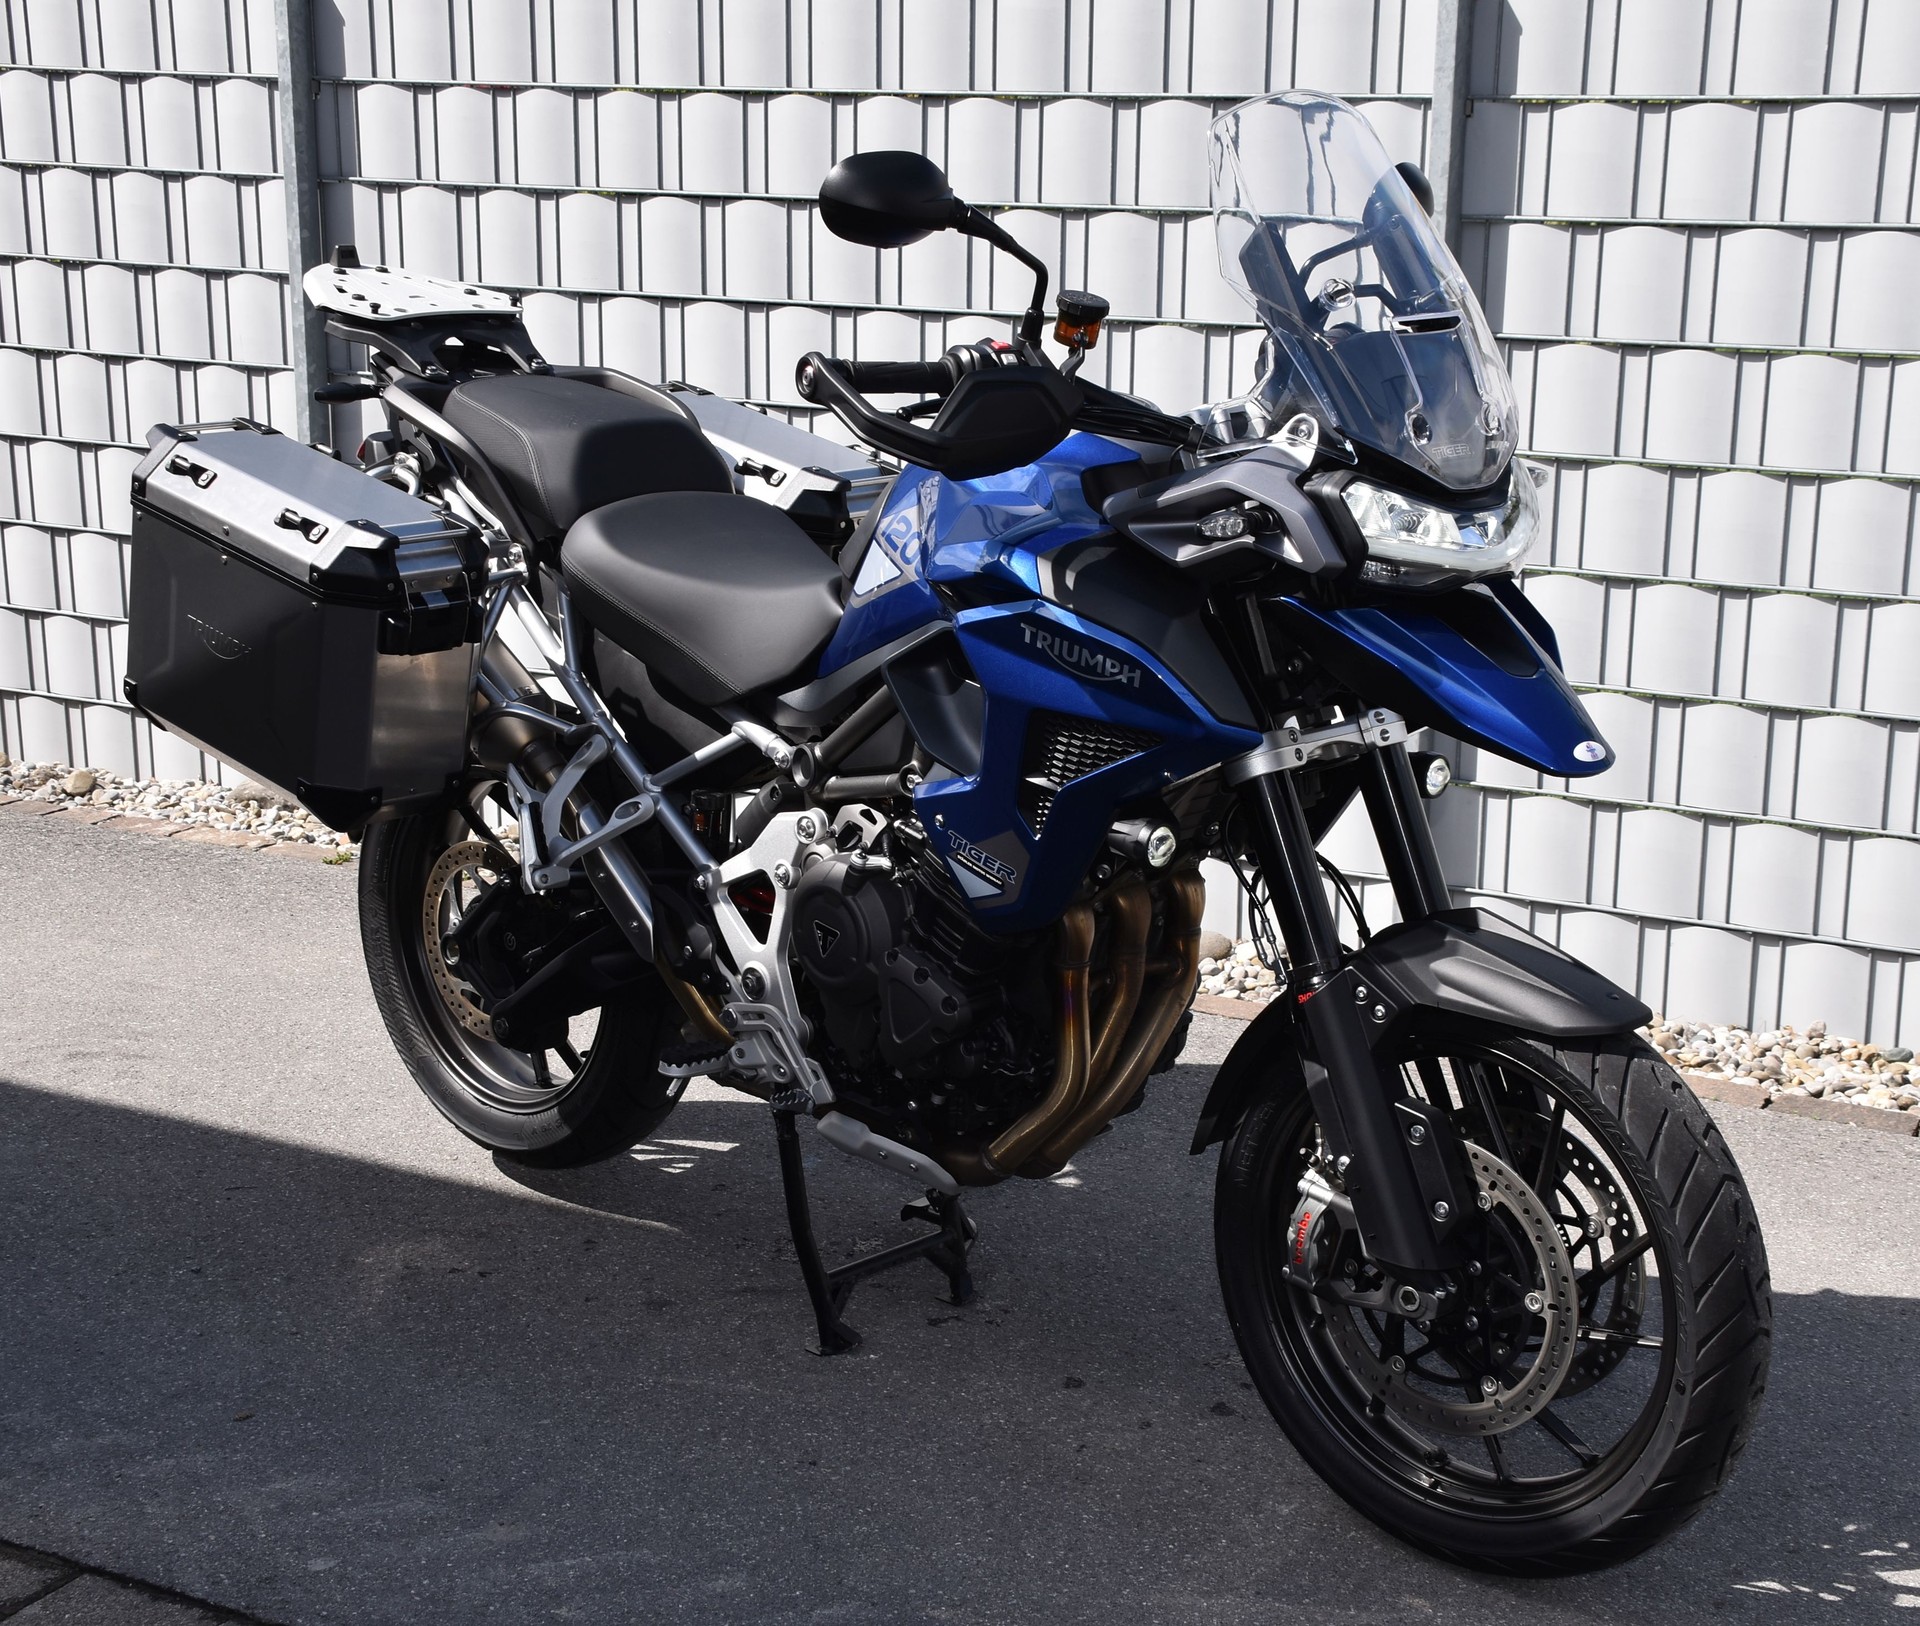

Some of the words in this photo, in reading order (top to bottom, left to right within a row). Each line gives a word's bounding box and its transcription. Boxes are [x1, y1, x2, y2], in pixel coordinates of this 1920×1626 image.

[1431, 443, 1472, 459] TIGER
[187, 614, 253, 663] TRIUMPH
[1020, 622, 1141, 688] TRIUMPH
[948, 830, 1017, 885] TIGER
[1293, 1211, 1312, 1265] brembo
